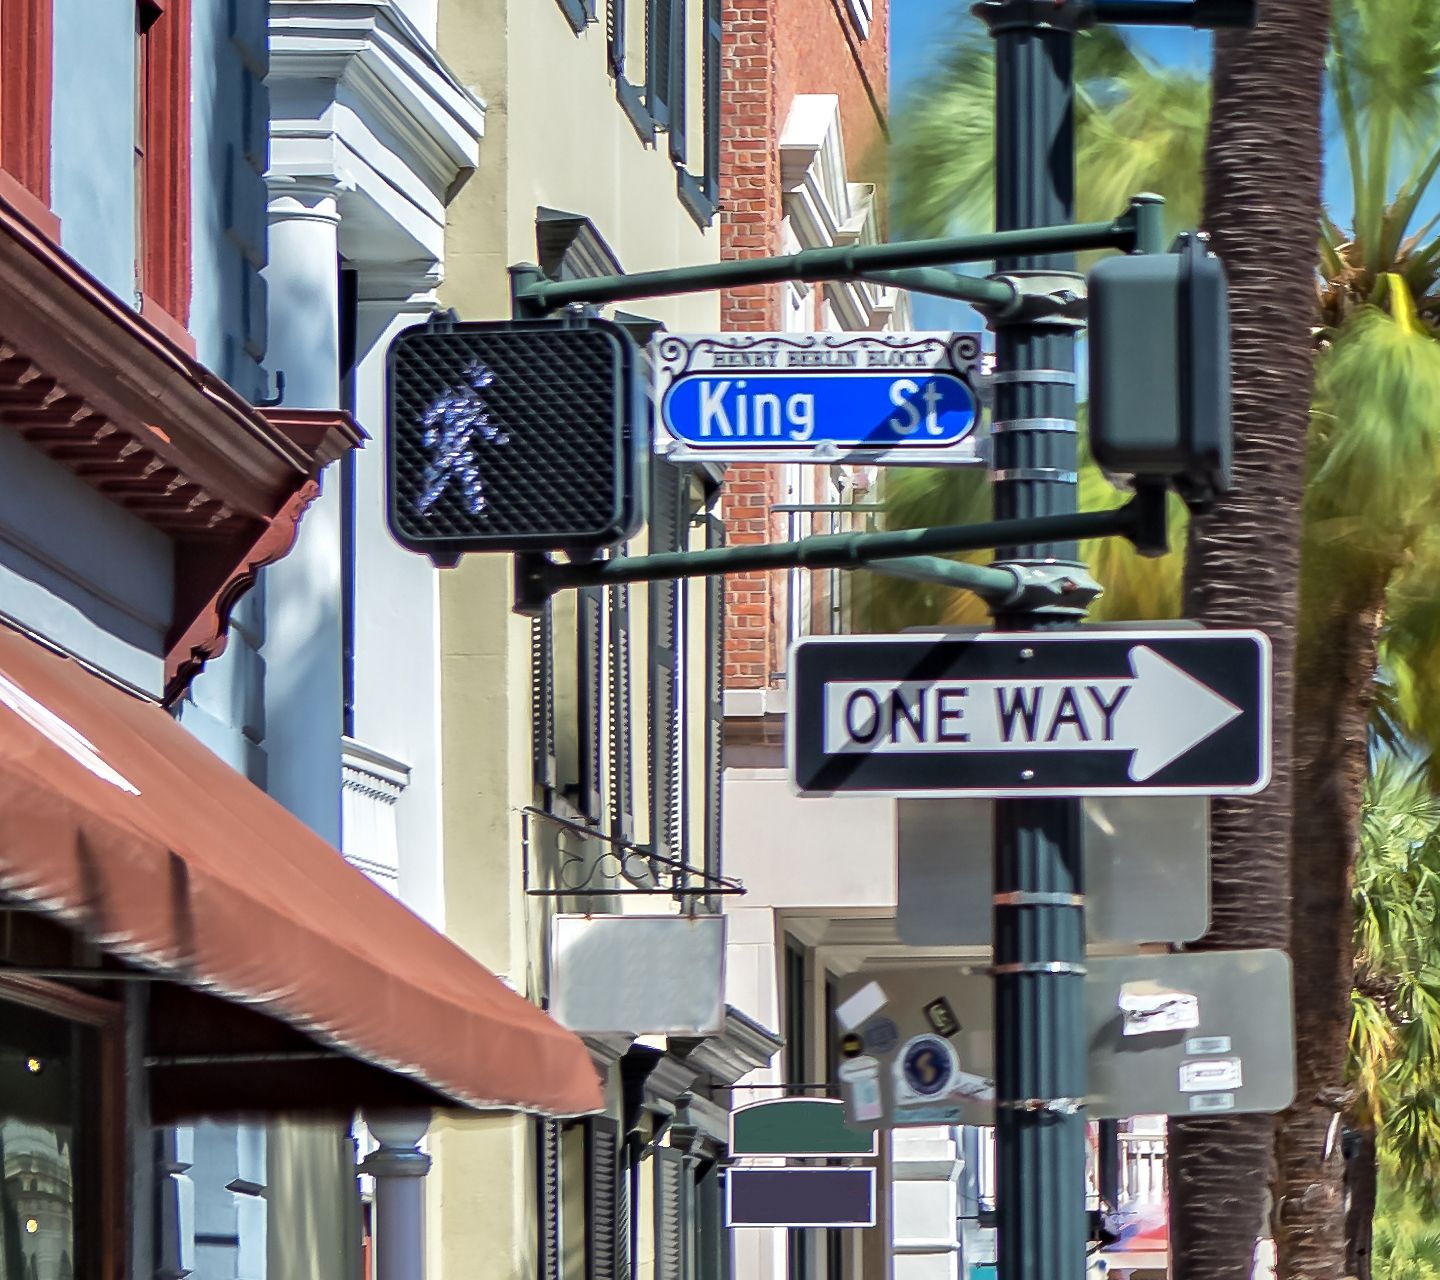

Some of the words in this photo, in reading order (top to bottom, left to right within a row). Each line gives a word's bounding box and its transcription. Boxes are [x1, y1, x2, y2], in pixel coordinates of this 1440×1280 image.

[699, 379, 815, 441] King
[888, 378, 945, 436] St
[845, 686, 971, 744] ONE
[993, 685, 1133, 743] WAY
